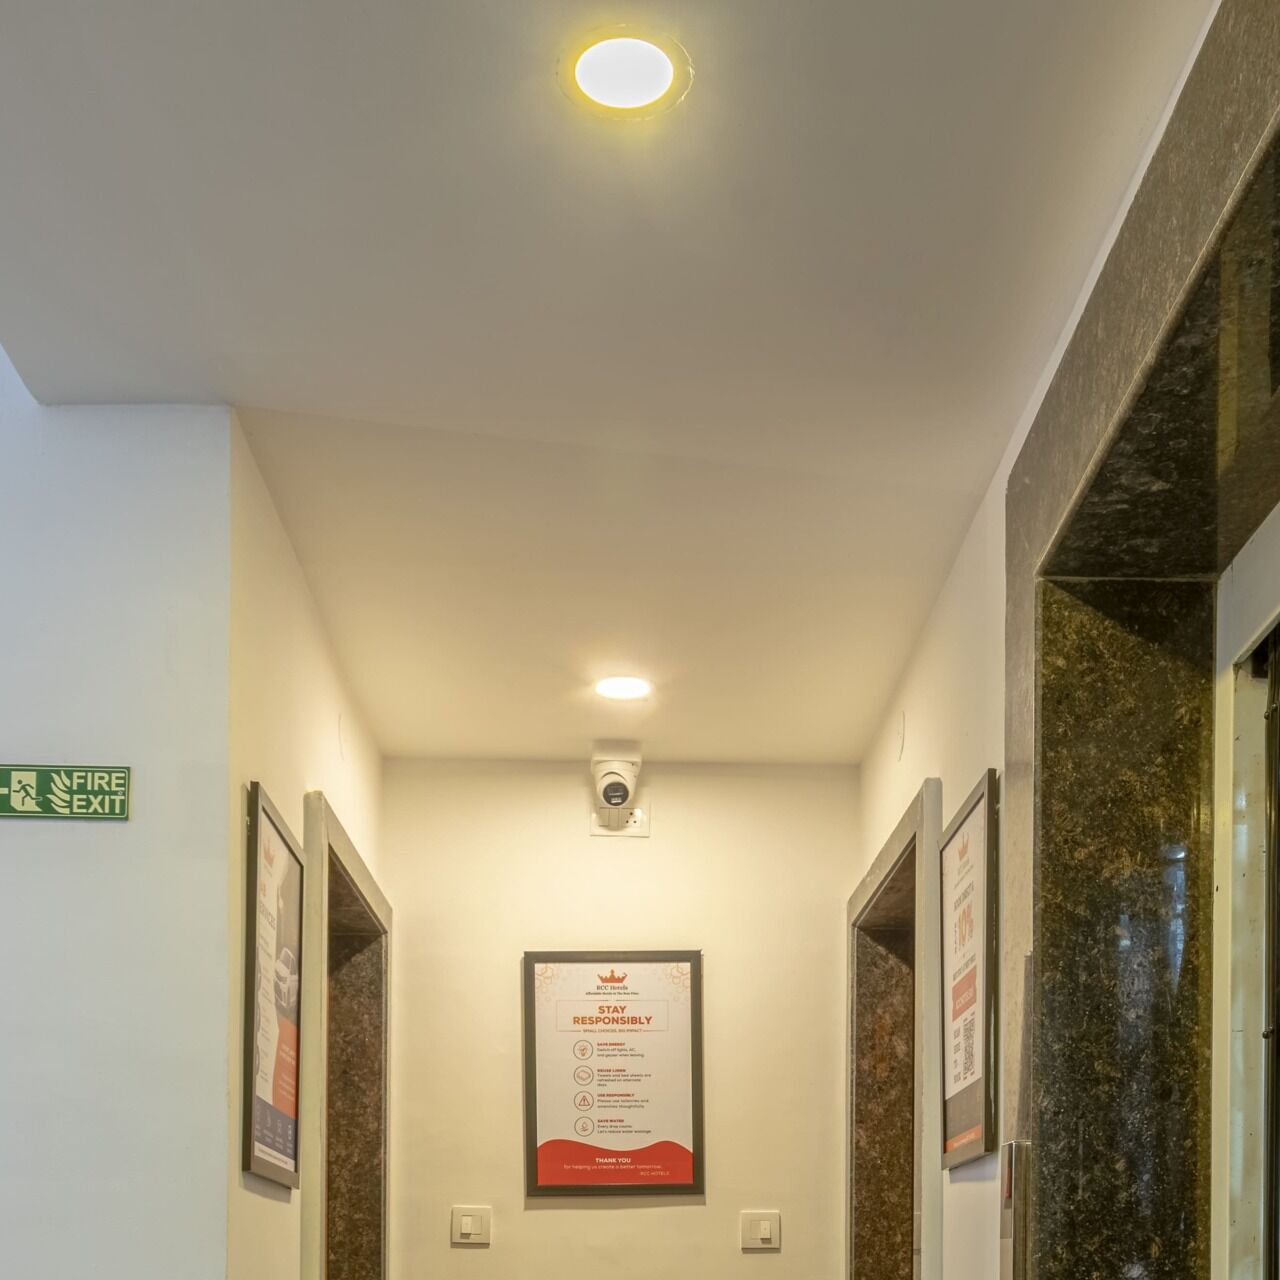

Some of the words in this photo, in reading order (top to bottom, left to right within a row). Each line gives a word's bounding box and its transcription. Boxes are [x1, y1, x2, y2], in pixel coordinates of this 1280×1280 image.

[72, 771, 126, 791] FIRE
[72, 794, 125, 814] EXIT
[598, 1005, 627, 1014] STAY
[573, 1016, 653, 1025] RESPONSIBLY
